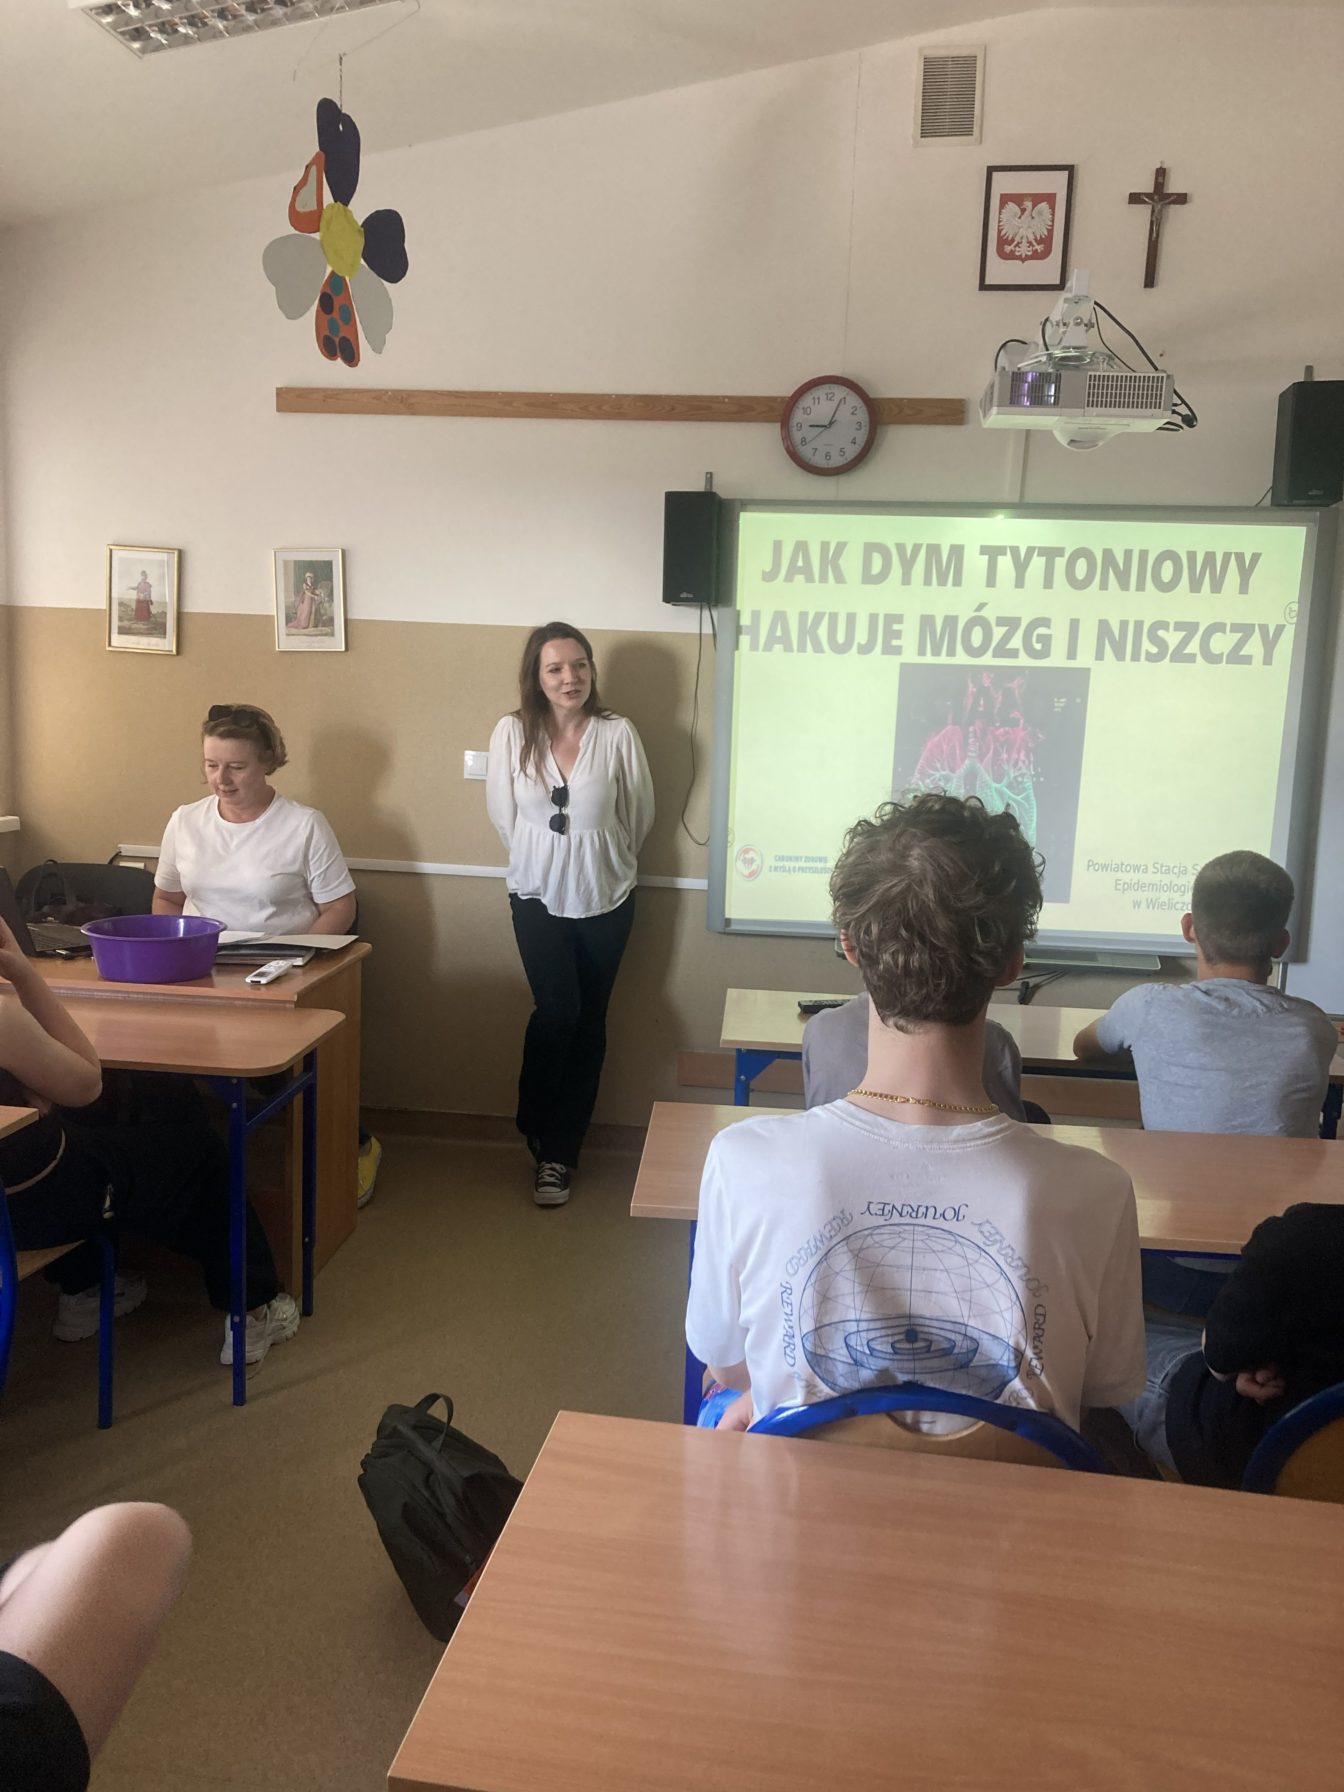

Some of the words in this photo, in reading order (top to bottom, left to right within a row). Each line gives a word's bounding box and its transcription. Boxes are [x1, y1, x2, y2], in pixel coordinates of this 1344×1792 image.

[812, 397, 820, 405] 11
[825, 392, 835, 401] 12
[841, 397, 846, 405] 1
[802, 406, 812, 416] 10
[851, 406, 857, 415] 2
[796, 422, 802, 431] 9
[856, 421, 862, 431] 3
[800, 437, 807, 446] 8
[851, 436, 857, 445] 4
[812, 448, 817, 456] 7
[825, 451, 831, 461] 6
[839, 448, 845, 456] 5
[761, 540, 848, 584] JAK
[861, 541, 965, 587] DYM
[979, 544, 1262, 595] TYTONIOWY
[736, 609, 904, 656] HAKUJE
[917, 602, 1052, 660] MÓZG
[1066, 618, 1080, 661] I
[1094, 618, 1286, 666] NISZCZY
[1086, 859, 1149, 874] Powiatowa
[1151, 862, 1188, 878] Stacja
[1132, 900, 1142, 909] w
[1146, 898, 1192, 911] Wieliczc
[861, 1201, 969, 1222] JOURNEY
[780, 1281, 797, 1367] REWARD
